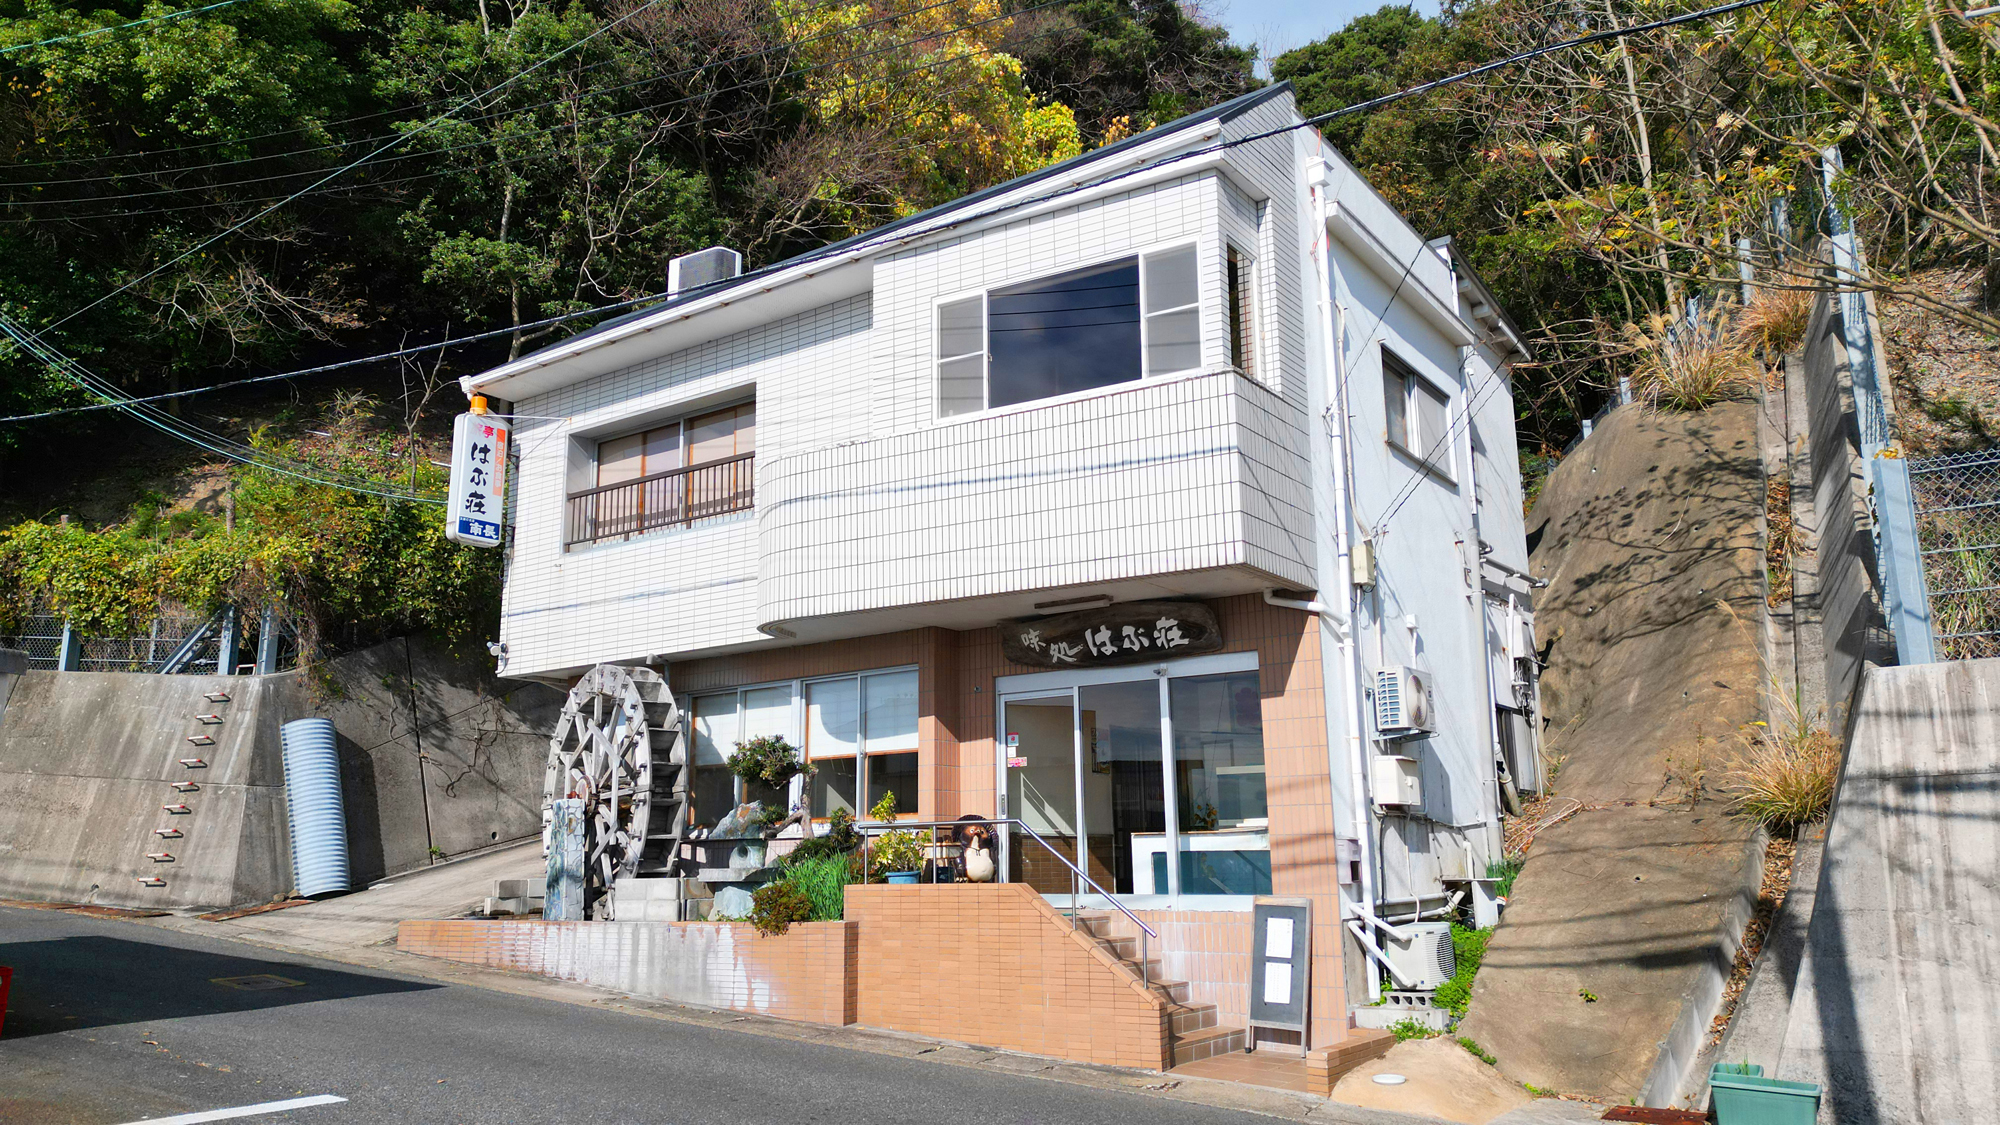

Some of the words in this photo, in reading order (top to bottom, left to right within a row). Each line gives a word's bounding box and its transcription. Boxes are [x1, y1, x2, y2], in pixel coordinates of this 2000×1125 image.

[465, 441, 491, 515] はぶ荘
[1021, 628, 1083, 663] 味処
[1084, 616, 1189, 657] はぶ荘
